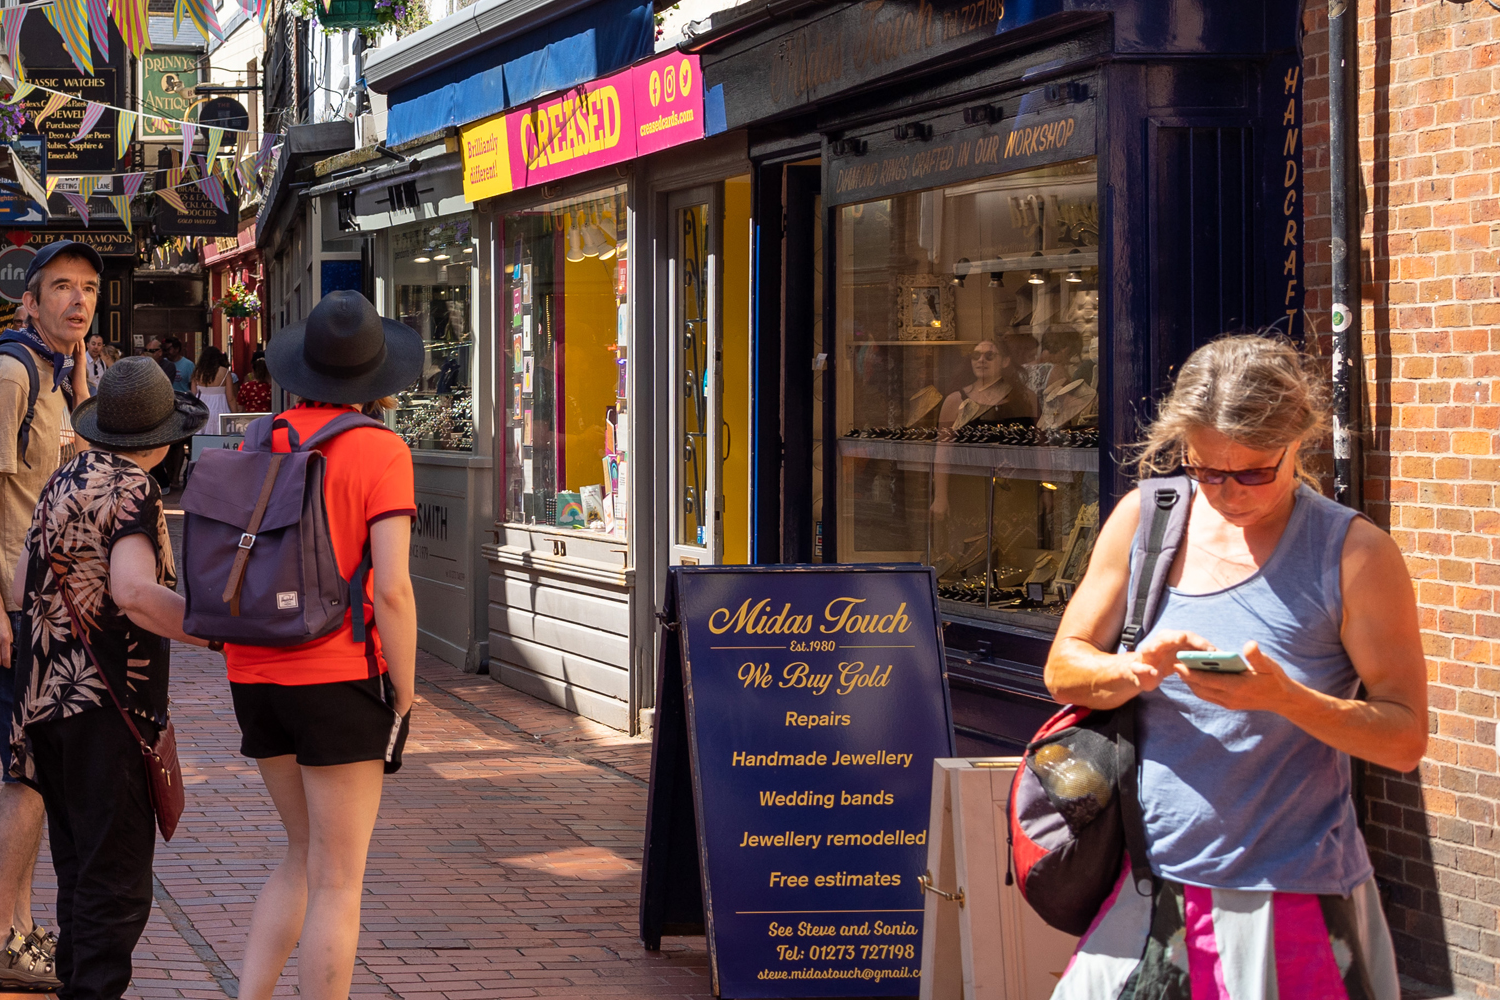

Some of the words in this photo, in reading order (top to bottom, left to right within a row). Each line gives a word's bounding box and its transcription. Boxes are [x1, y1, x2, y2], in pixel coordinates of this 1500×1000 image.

[144, 55, 196, 79] PRINNYS
[770, 30, 843, 103] Midas
[63, 77, 106, 87] WATCHES
[145, 90, 194, 111] ANTIQU
[519, 84, 622, 171] CREASED
[639, 108, 694, 138] creasedcards.com
[47, 151, 79, 160] Emeralds
[467, 133, 499, 159] Brilliantly
[836, 163, 879, 194] DIAMOND
[880, 155, 911, 187] RINGS
[911, 144, 955, 178] CRAFTED
[956, 141, 973, 168] IN
[974, 134, 1001, 166] OUR
[1002, 117, 1075, 160] WORKSHOP
[469, 161, 499, 186] different!
[97, 182, 111, 190] LANE
[176, 209, 218, 217] BOOCHES
[1283, 66, 1300, 348] HANDCRAFT
[73, 234, 133, 244] DIAMONDS
[0, 263, 27, 281] rin
[707, 597, 813, 636] Midas
[819, 596, 912, 635] Touch
[789, 640, 836, 652] Est.1980
[737, 661, 773, 689] We
[778, 661, 833, 695] Buy
[836, 661, 891, 696] Gold
[784, 711, 852, 730] Repairs
[731, 750, 828, 767] Handmade
[832, 750, 913, 770] Jewellery
[759, 790, 835, 809] Wedding
[840, 790, 895, 806] bands
[739, 830, 821, 850] Jewellery
[826, 829, 927, 847] remodelled
[769, 871, 810, 888] Free
[814, 871, 902, 888] estimates
[768, 921, 795, 937] See
[797, 921, 837, 937] Steve
[839, 921, 871, 937] and
[873, 921, 918, 937] Sonia
[776, 944, 805, 961] Tel:
[809, 944, 856, 961] 01273
[859, 943, 916, 961] 727198
